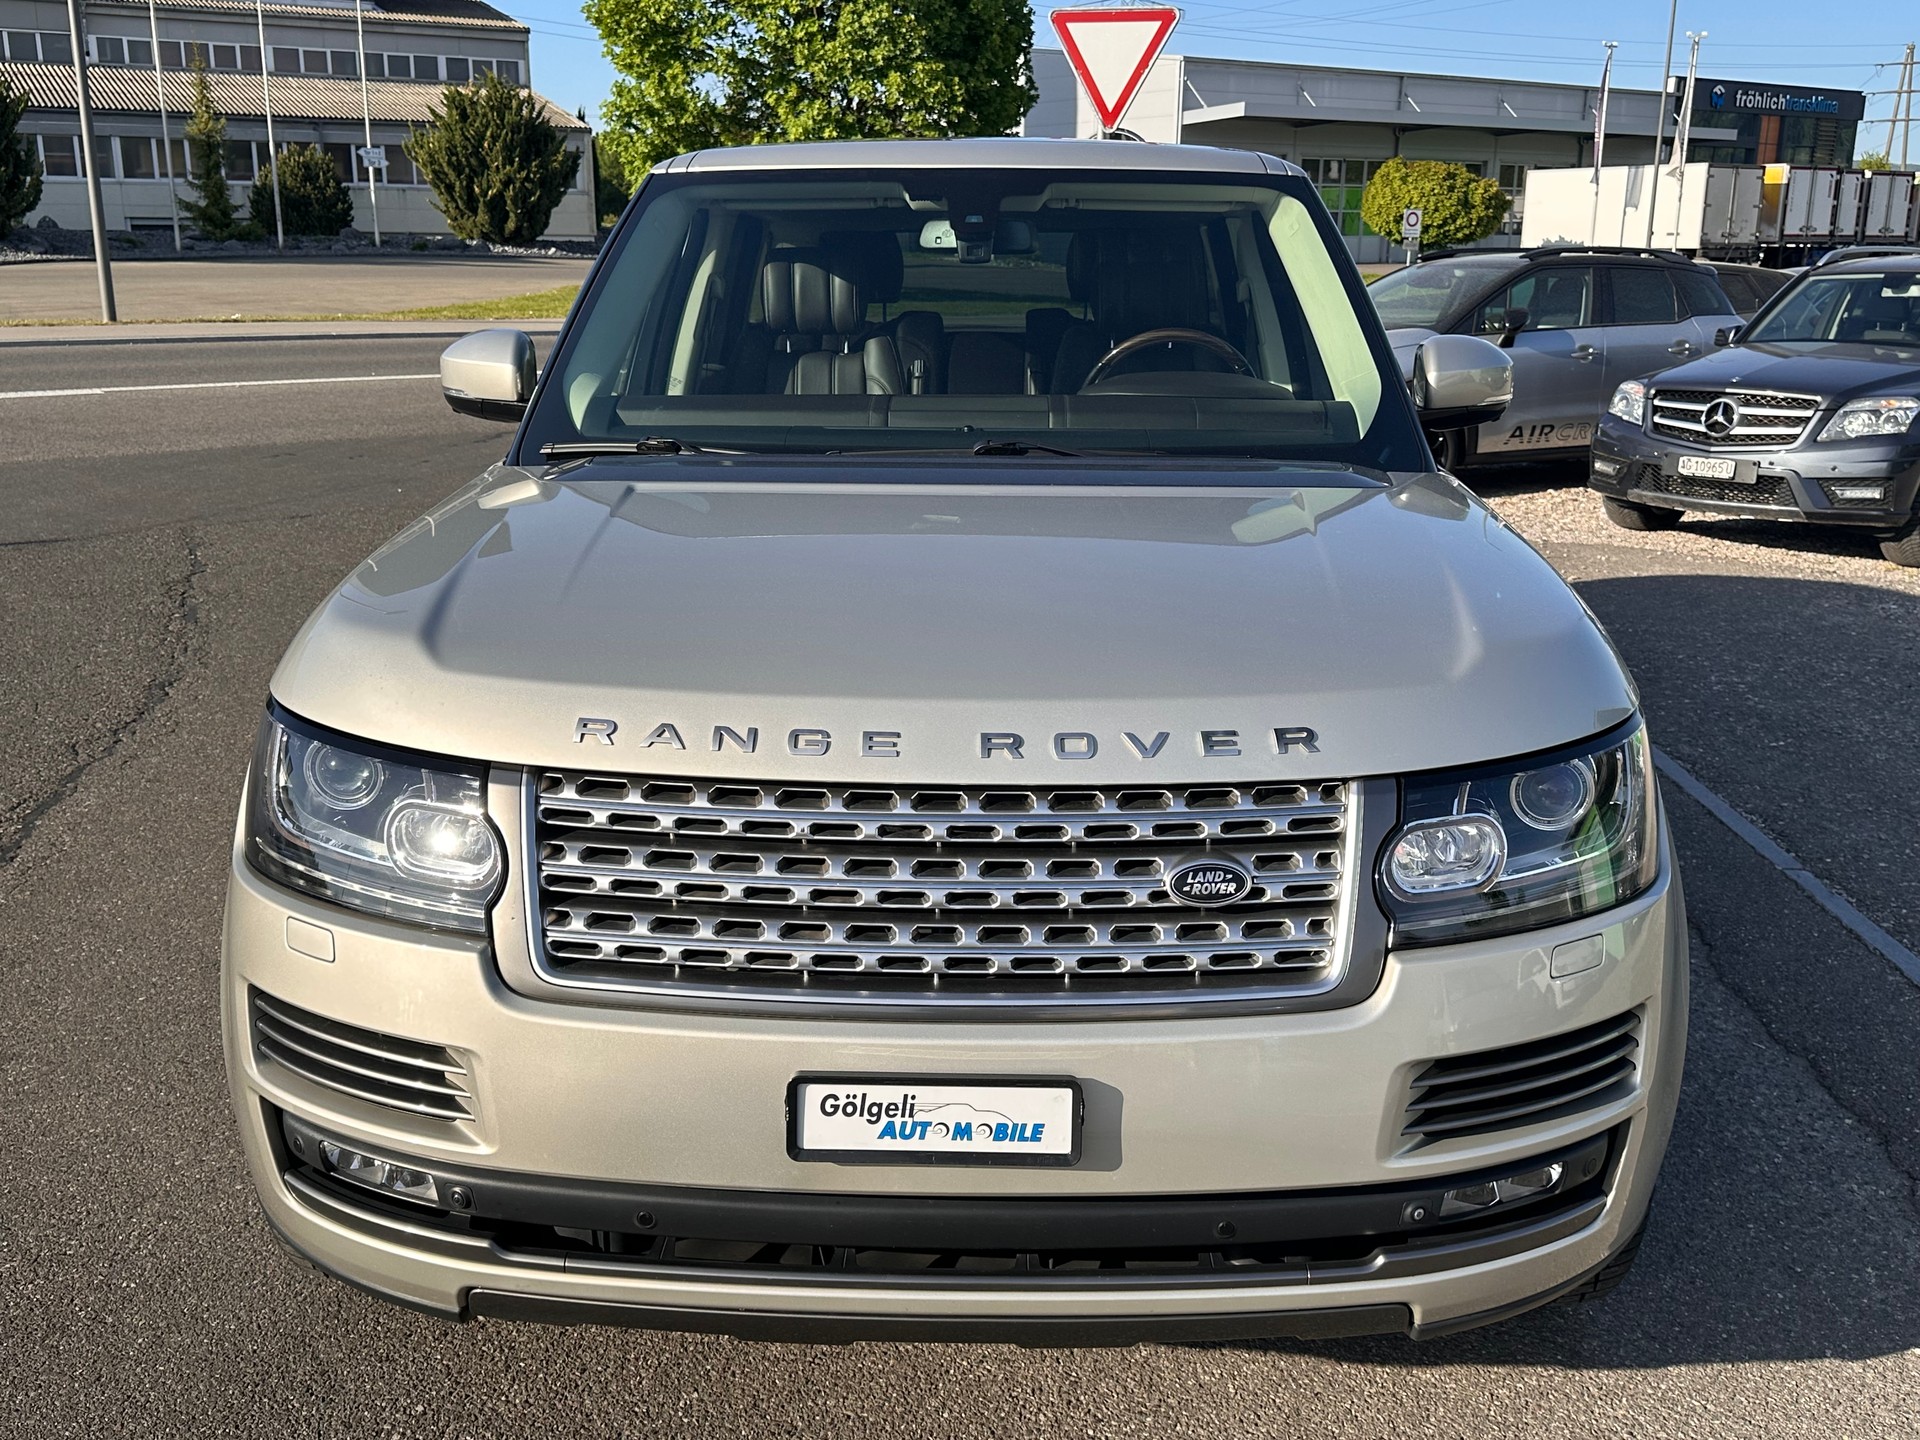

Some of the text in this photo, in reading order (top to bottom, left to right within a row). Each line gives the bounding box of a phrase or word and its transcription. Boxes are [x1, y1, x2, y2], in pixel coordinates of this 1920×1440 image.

[1503, 422, 1594, 445] AIRCR
[572, 716, 1321, 760] RANGE ROVER
[1186, 871, 1225, 884] LAND
[1190, 882, 1237, 895] ROVER
[819, 1092, 917, 1125] Gölgeli
